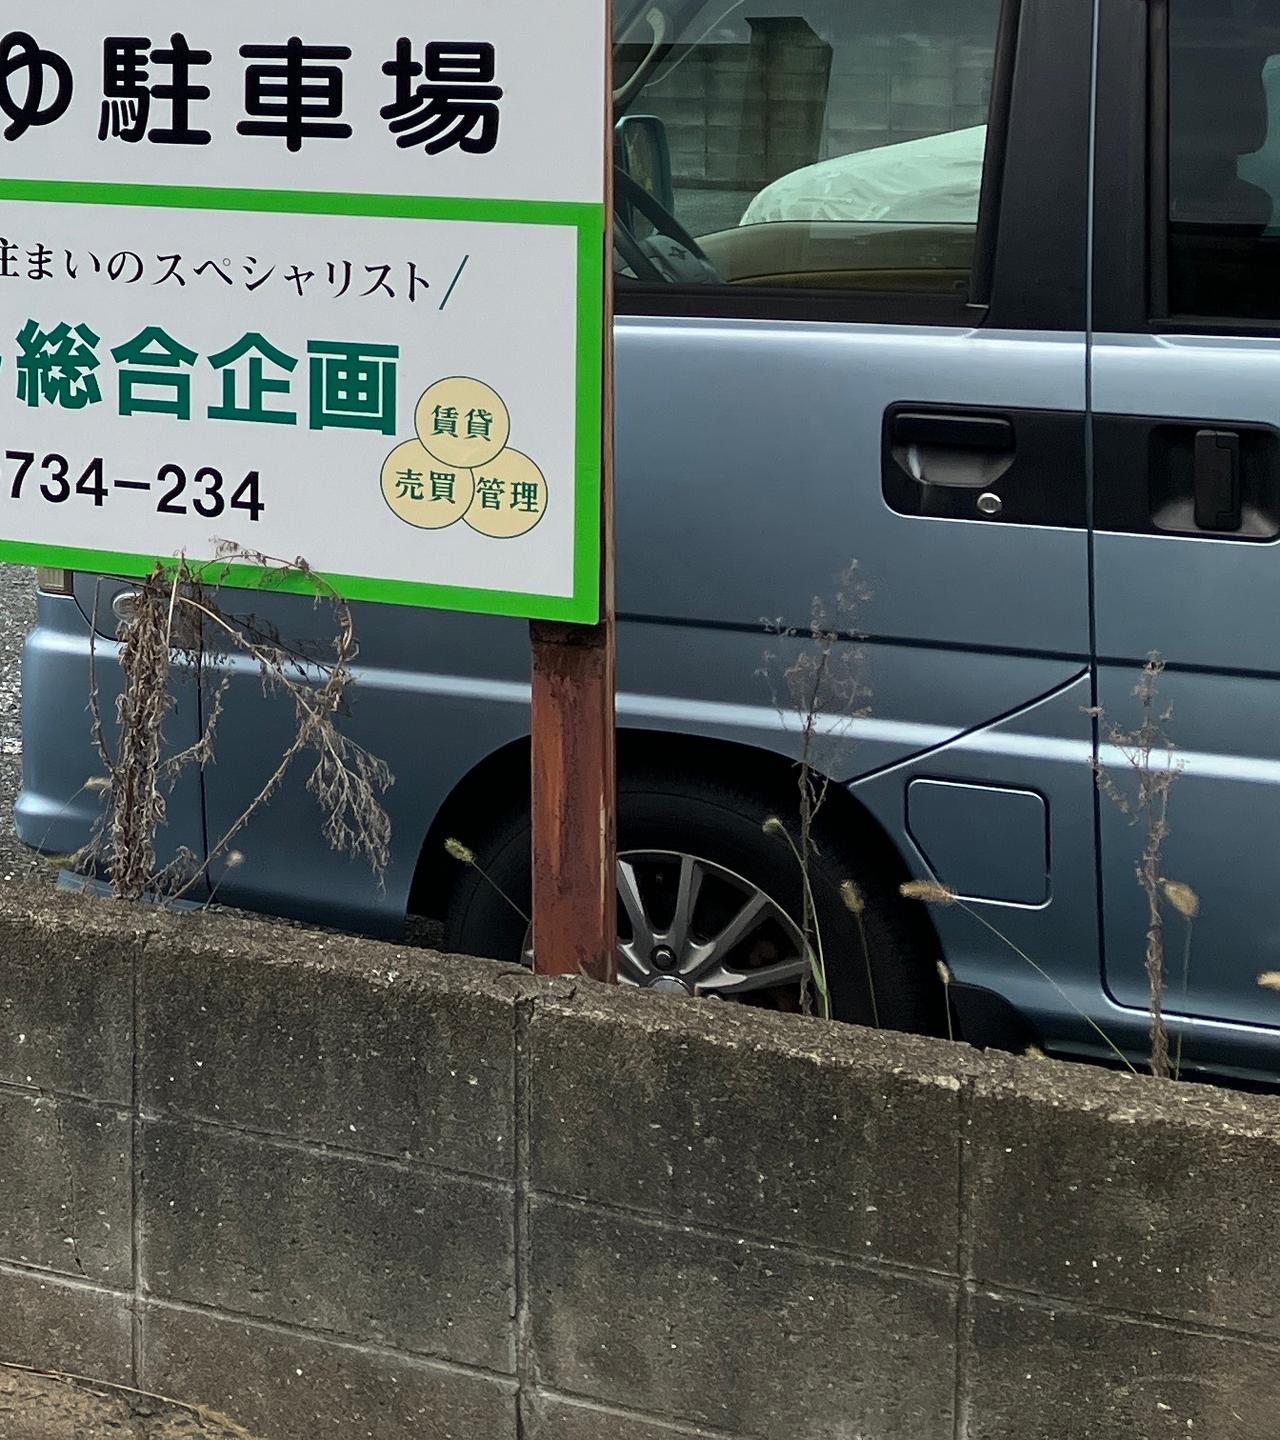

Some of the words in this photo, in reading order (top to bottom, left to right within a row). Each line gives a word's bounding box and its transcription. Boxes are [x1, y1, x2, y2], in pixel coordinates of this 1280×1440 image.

[431, 404, 493, 442] 賃貸
[395, 468, 457, 505] 売買
[476, 476, 539, 513] 管理
